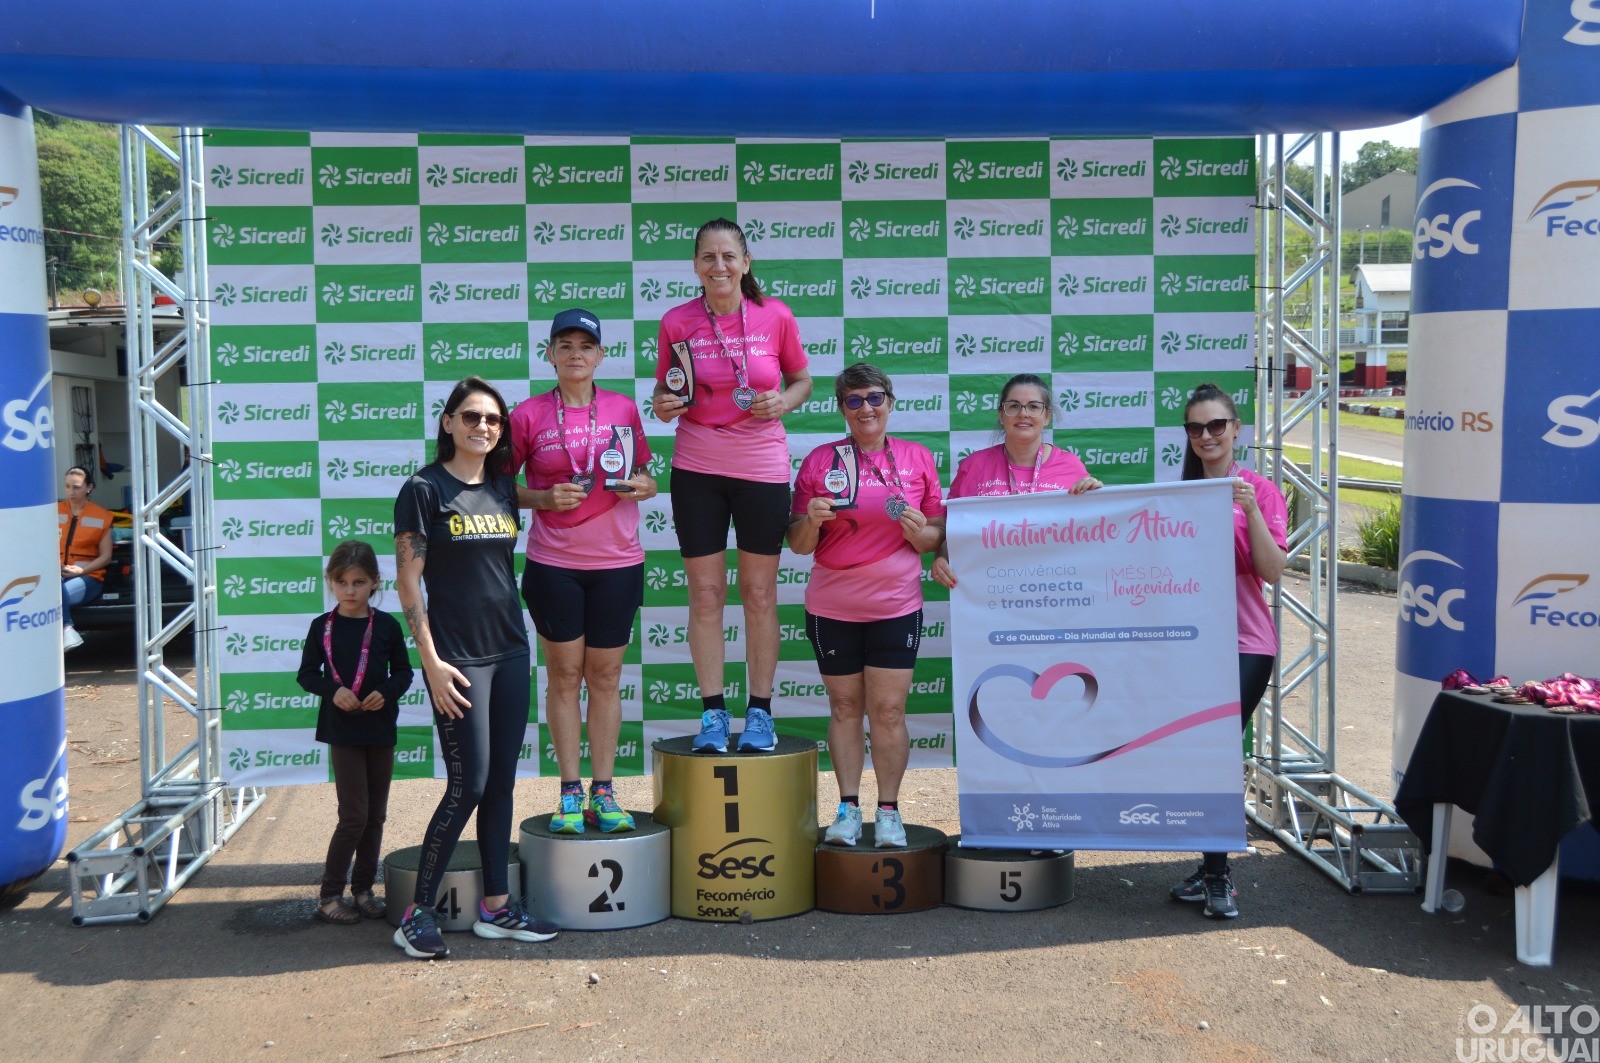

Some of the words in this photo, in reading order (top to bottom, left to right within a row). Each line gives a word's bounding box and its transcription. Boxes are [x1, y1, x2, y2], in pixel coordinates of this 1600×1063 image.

[345, 168, 411, 185] Sicredi
[452, 167, 518, 184] Sicredi
[558, 166, 624, 183] Sicredi
[664, 165, 730, 182] Sicredi
[769, 164, 835, 181] Sicredi
[874, 163, 939, 180] Sicredi
[978, 162, 1043, 179] Sicredi
[1081, 161, 1146, 178] Sicredi
[1185, 160, 1249, 177] Sicredi
[238, 169, 304, 186] Sicredi
[453, 225, 519, 243] Sicredi
[559, 224, 625, 241] Sicredi
[770, 222, 835, 239] Sicredi
[875, 221, 940, 238] Sicredi
[979, 220, 1043, 237] Sicredi
[1081, 219, 1147, 236] Sicredi
[1184, 218, 1249, 235] Sicredi
[240, 228, 306, 245] Sicredi
[347, 227, 413, 244] Sicredi
[560, 283, 626, 300] Sicredi
[666, 281, 702, 299] Sicr
[771, 280, 836, 297] Sicredi
[875, 279, 940, 296] Sicredi
[979, 278, 1044, 295] Sicredi
[1081, 276, 1147, 294] Sicredi
[1184, 275, 1250, 292] Sicredi
[241, 286, 307, 304] Sicredi
[348, 285, 414, 302] Sicredi
[455, 284, 521, 301] Sicredi
[802, 338, 838, 355] redi
[875, 336, 941, 354] Sicredi
[979, 335, 1044, 352] Sicredi
[1081, 334, 1147, 351] Sicredi
[1184, 332, 1250, 350] Sicredi
[243, 345, 309, 362] Sicredi
[350, 344, 416, 361] Sicredi
[456, 342, 522, 359] Sicredi
[751, 346, 767, 357] Rosa
[1081, 391, 1148, 408] Sicredi
[244, 403, 311, 421] Sicredi
[351, 402, 417, 419] Sicredi
[1461, 412, 1493, 432] RS
[1081, 448, 1148, 465] Sicredi
[246, 461, 313, 479] Sicredi
[352, 460, 419, 477] Sicredi
[248, 519, 314, 537] Sicredi
[981, 516, 1120, 549] Maturidade
[1126, 509, 1200, 543] Ativa
[986, 564, 1077, 579] Convivência
[1111, 564, 1146, 580] MÊS
[1150, 566, 1174, 580] DA
[249, 577, 316, 595] Sicredi
[1019, 580, 1084, 593] conecta
[1113, 578, 1202, 606] longevidade
[987, 600, 997, 609] e
[1000, 595, 1095, 609] transforma!
[1007, 634, 1017, 642] de
[1019, 633, 1055, 642] Outubro
[1064, 632, 1079, 640] Dia
[1081, 631, 1116, 640] Mundial
[1118, 631, 1130, 639] da
[1132, 631, 1164, 639] Pessoa
[1166, 630, 1191, 638] Idosa
[908, 735, 946, 753] redi
[254, 749, 321, 767] Sicredi
[713, 765, 739, 833] 1
[1041, 813, 1081, 821] Maturidade
[1119, 810, 1160, 825] Sesc
[697, 852, 774, 880] Sesc
[588, 859, 625, 913] 2
[871, 857, 905, 910] 3
[1000, 871, 1022, 902] 5
[697, 887, 775, 902] Fecomércio
[697, 905, 740, 918] Senac
